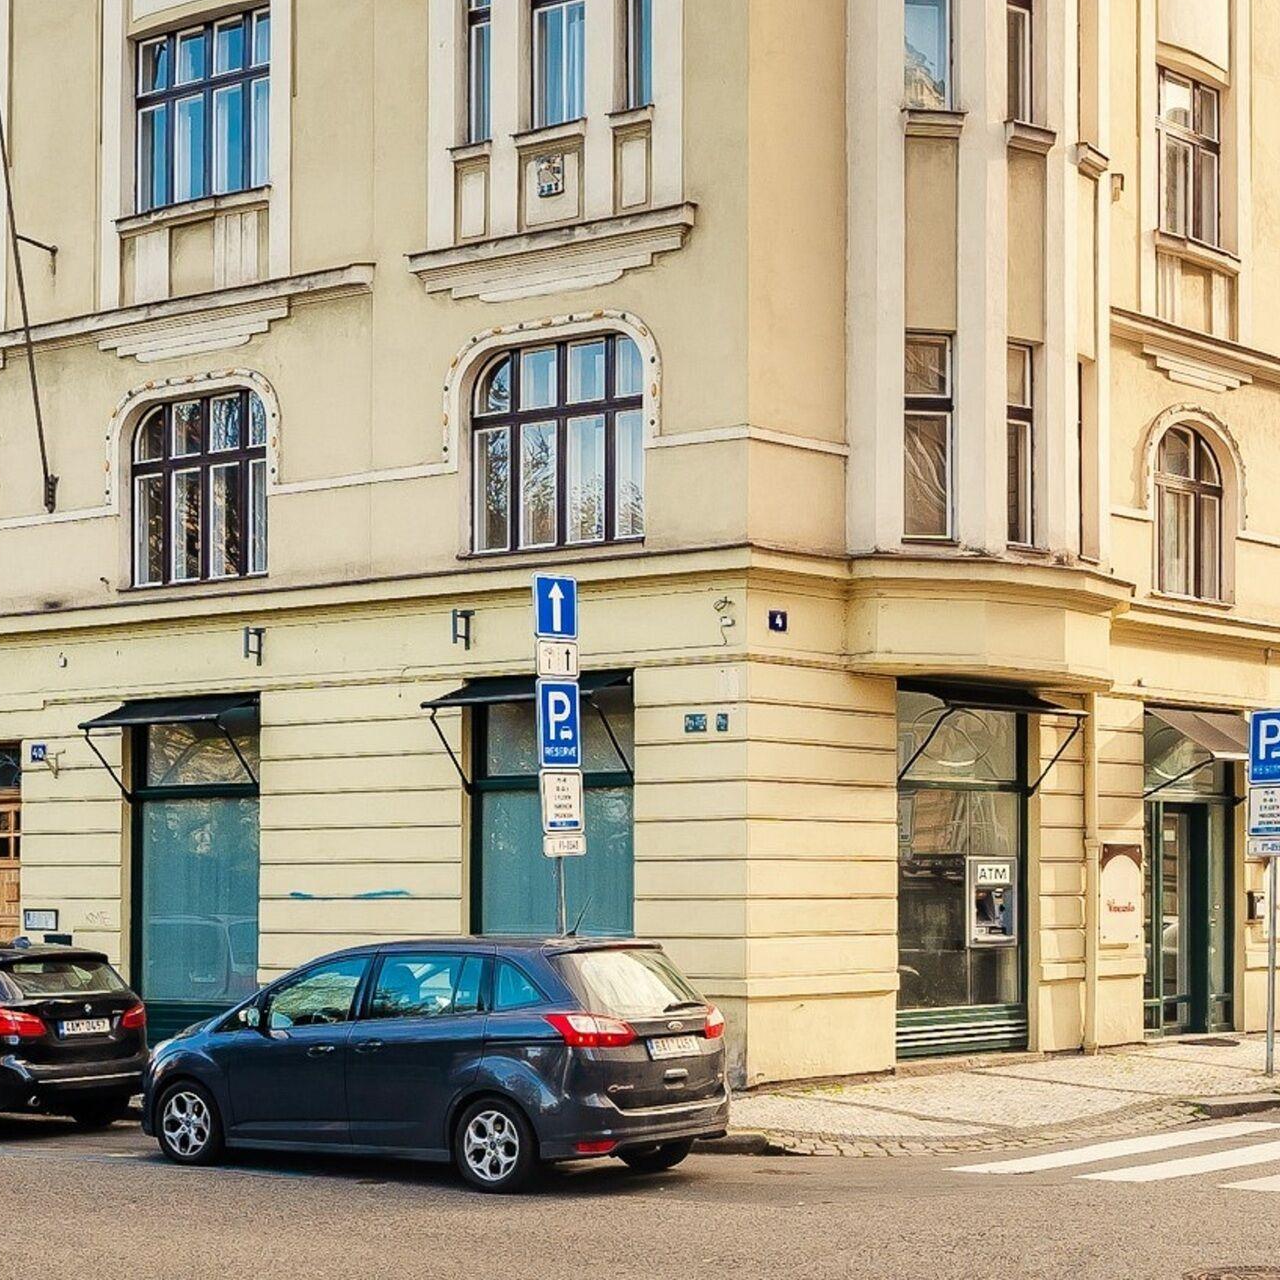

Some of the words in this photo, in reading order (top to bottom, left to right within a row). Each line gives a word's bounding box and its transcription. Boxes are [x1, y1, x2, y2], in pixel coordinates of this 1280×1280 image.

[775, 614, 783, 628] 4
[548, 691, 571, 740] P
[979, 867, 1007, 880] ATM
